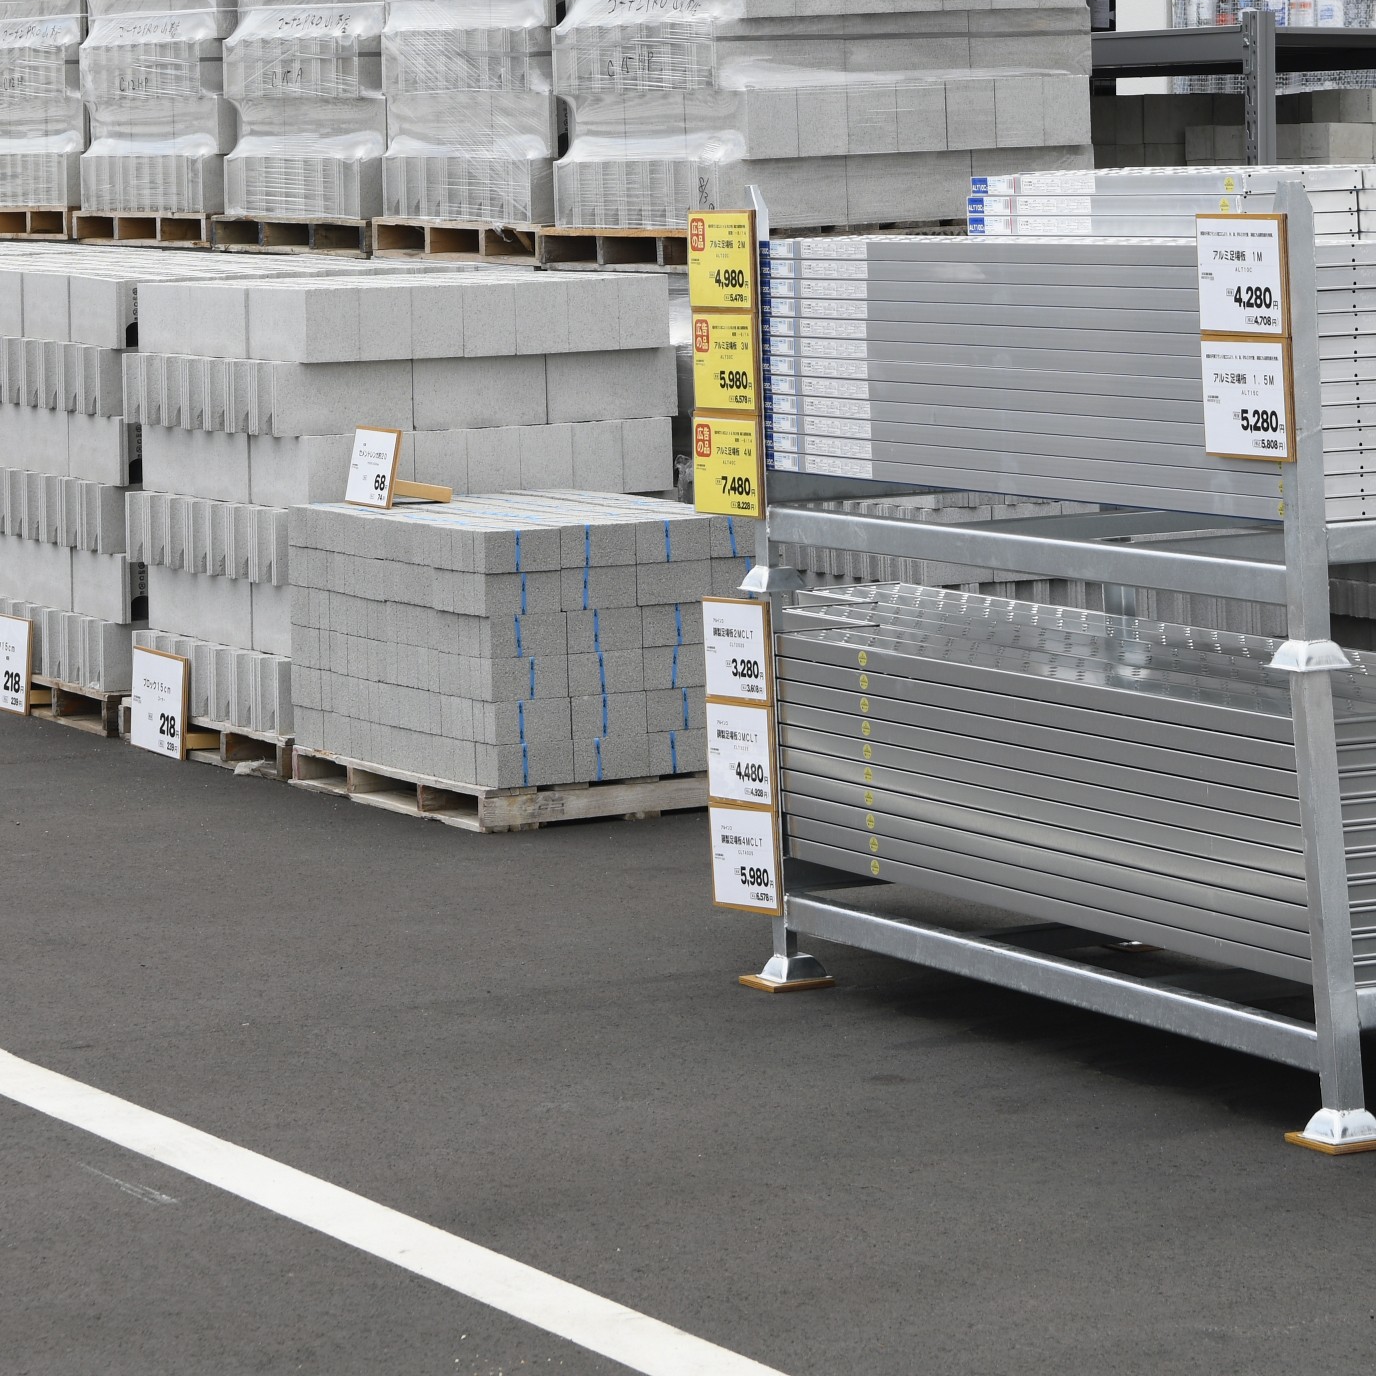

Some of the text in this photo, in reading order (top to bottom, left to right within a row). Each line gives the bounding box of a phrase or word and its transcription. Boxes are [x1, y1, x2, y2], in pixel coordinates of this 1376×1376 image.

[691, 221, 704, 234] 広告
[691, 235, 704, 248] の品
[1213, 250, 1263, 262] アルミ足場板 1M
[695, 322, 708, 336] 広告
[695, 337, 708, 350] の品
[1213, 373, 1247, 384] アルミ足場板
[697, 427, 710, 440] 広告
[697, 441, 710, 454] の品
